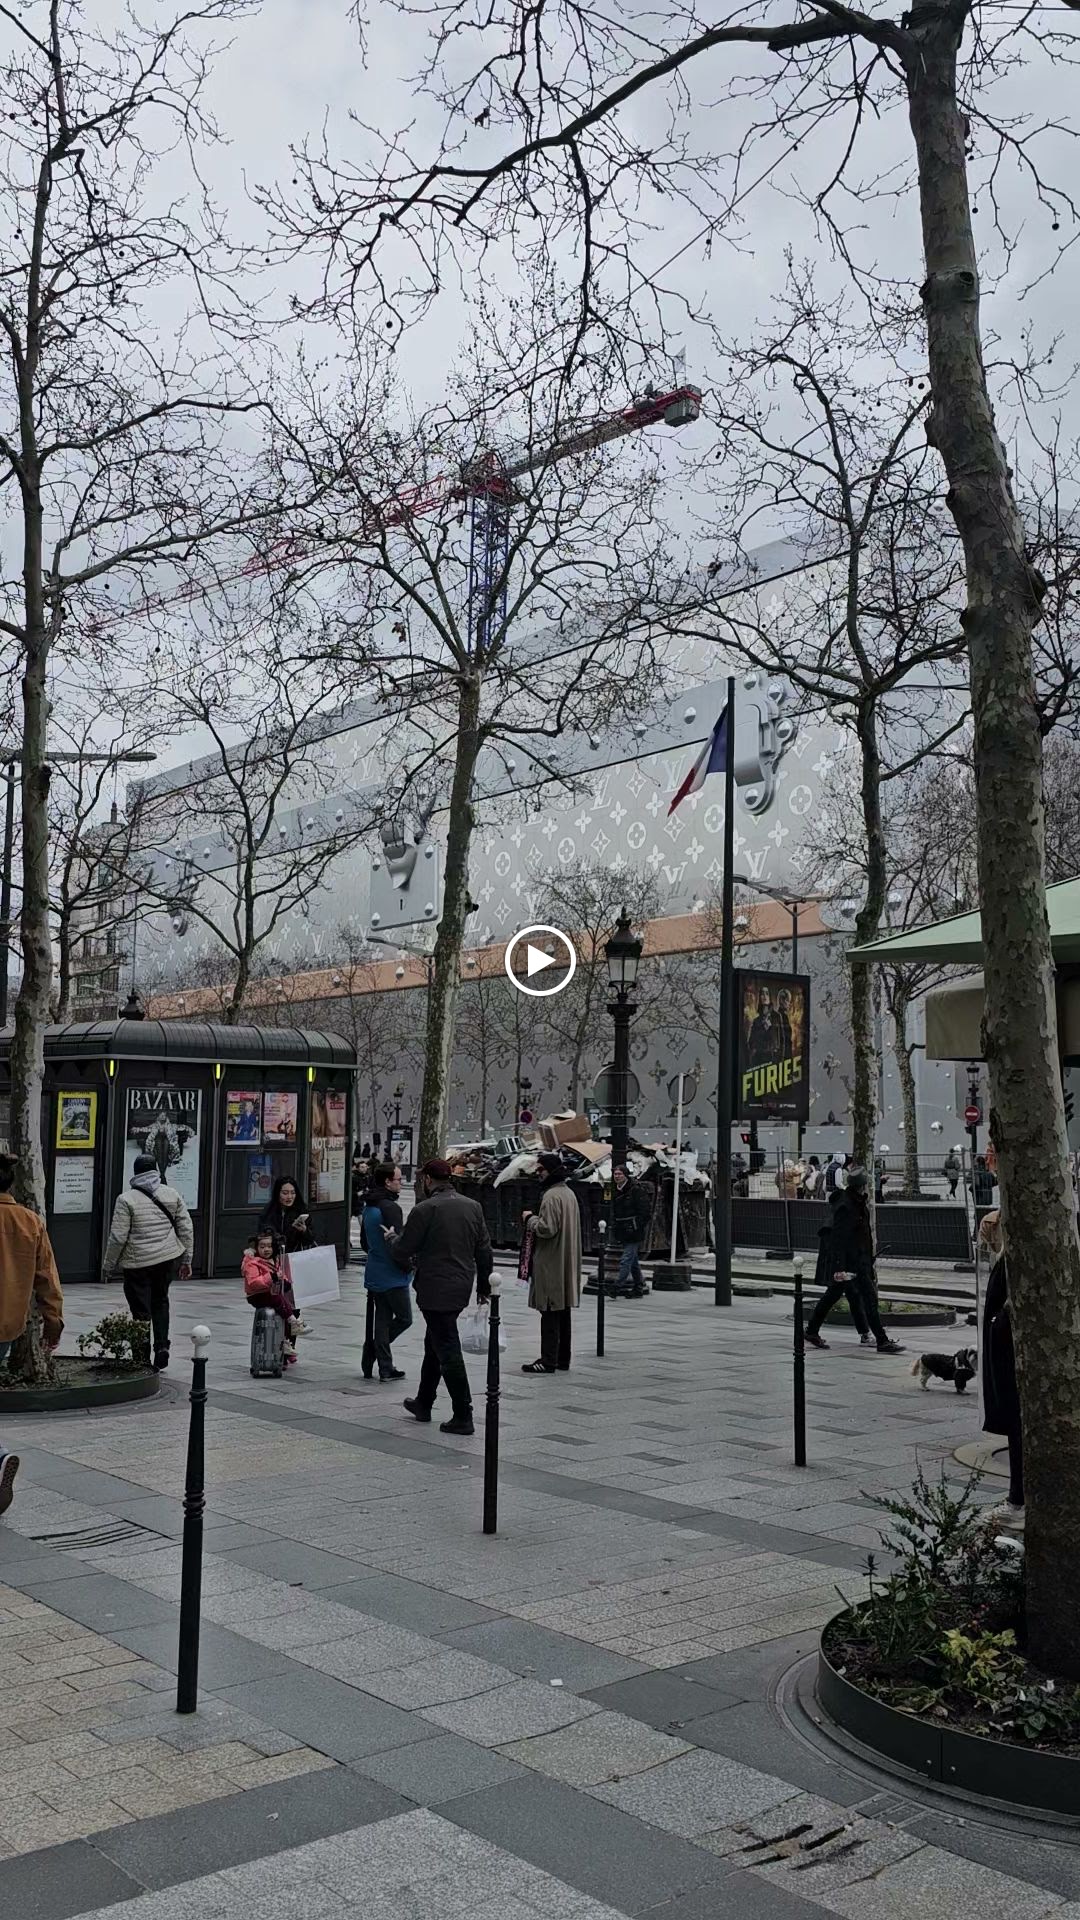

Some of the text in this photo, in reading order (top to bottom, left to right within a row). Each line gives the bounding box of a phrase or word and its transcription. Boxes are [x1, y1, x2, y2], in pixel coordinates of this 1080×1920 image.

[743, 1055, 802, 1102] FURIES
[130, 1089, 195, 1110] BAZAAR
[311, 1137, 327, 1149] NOT
